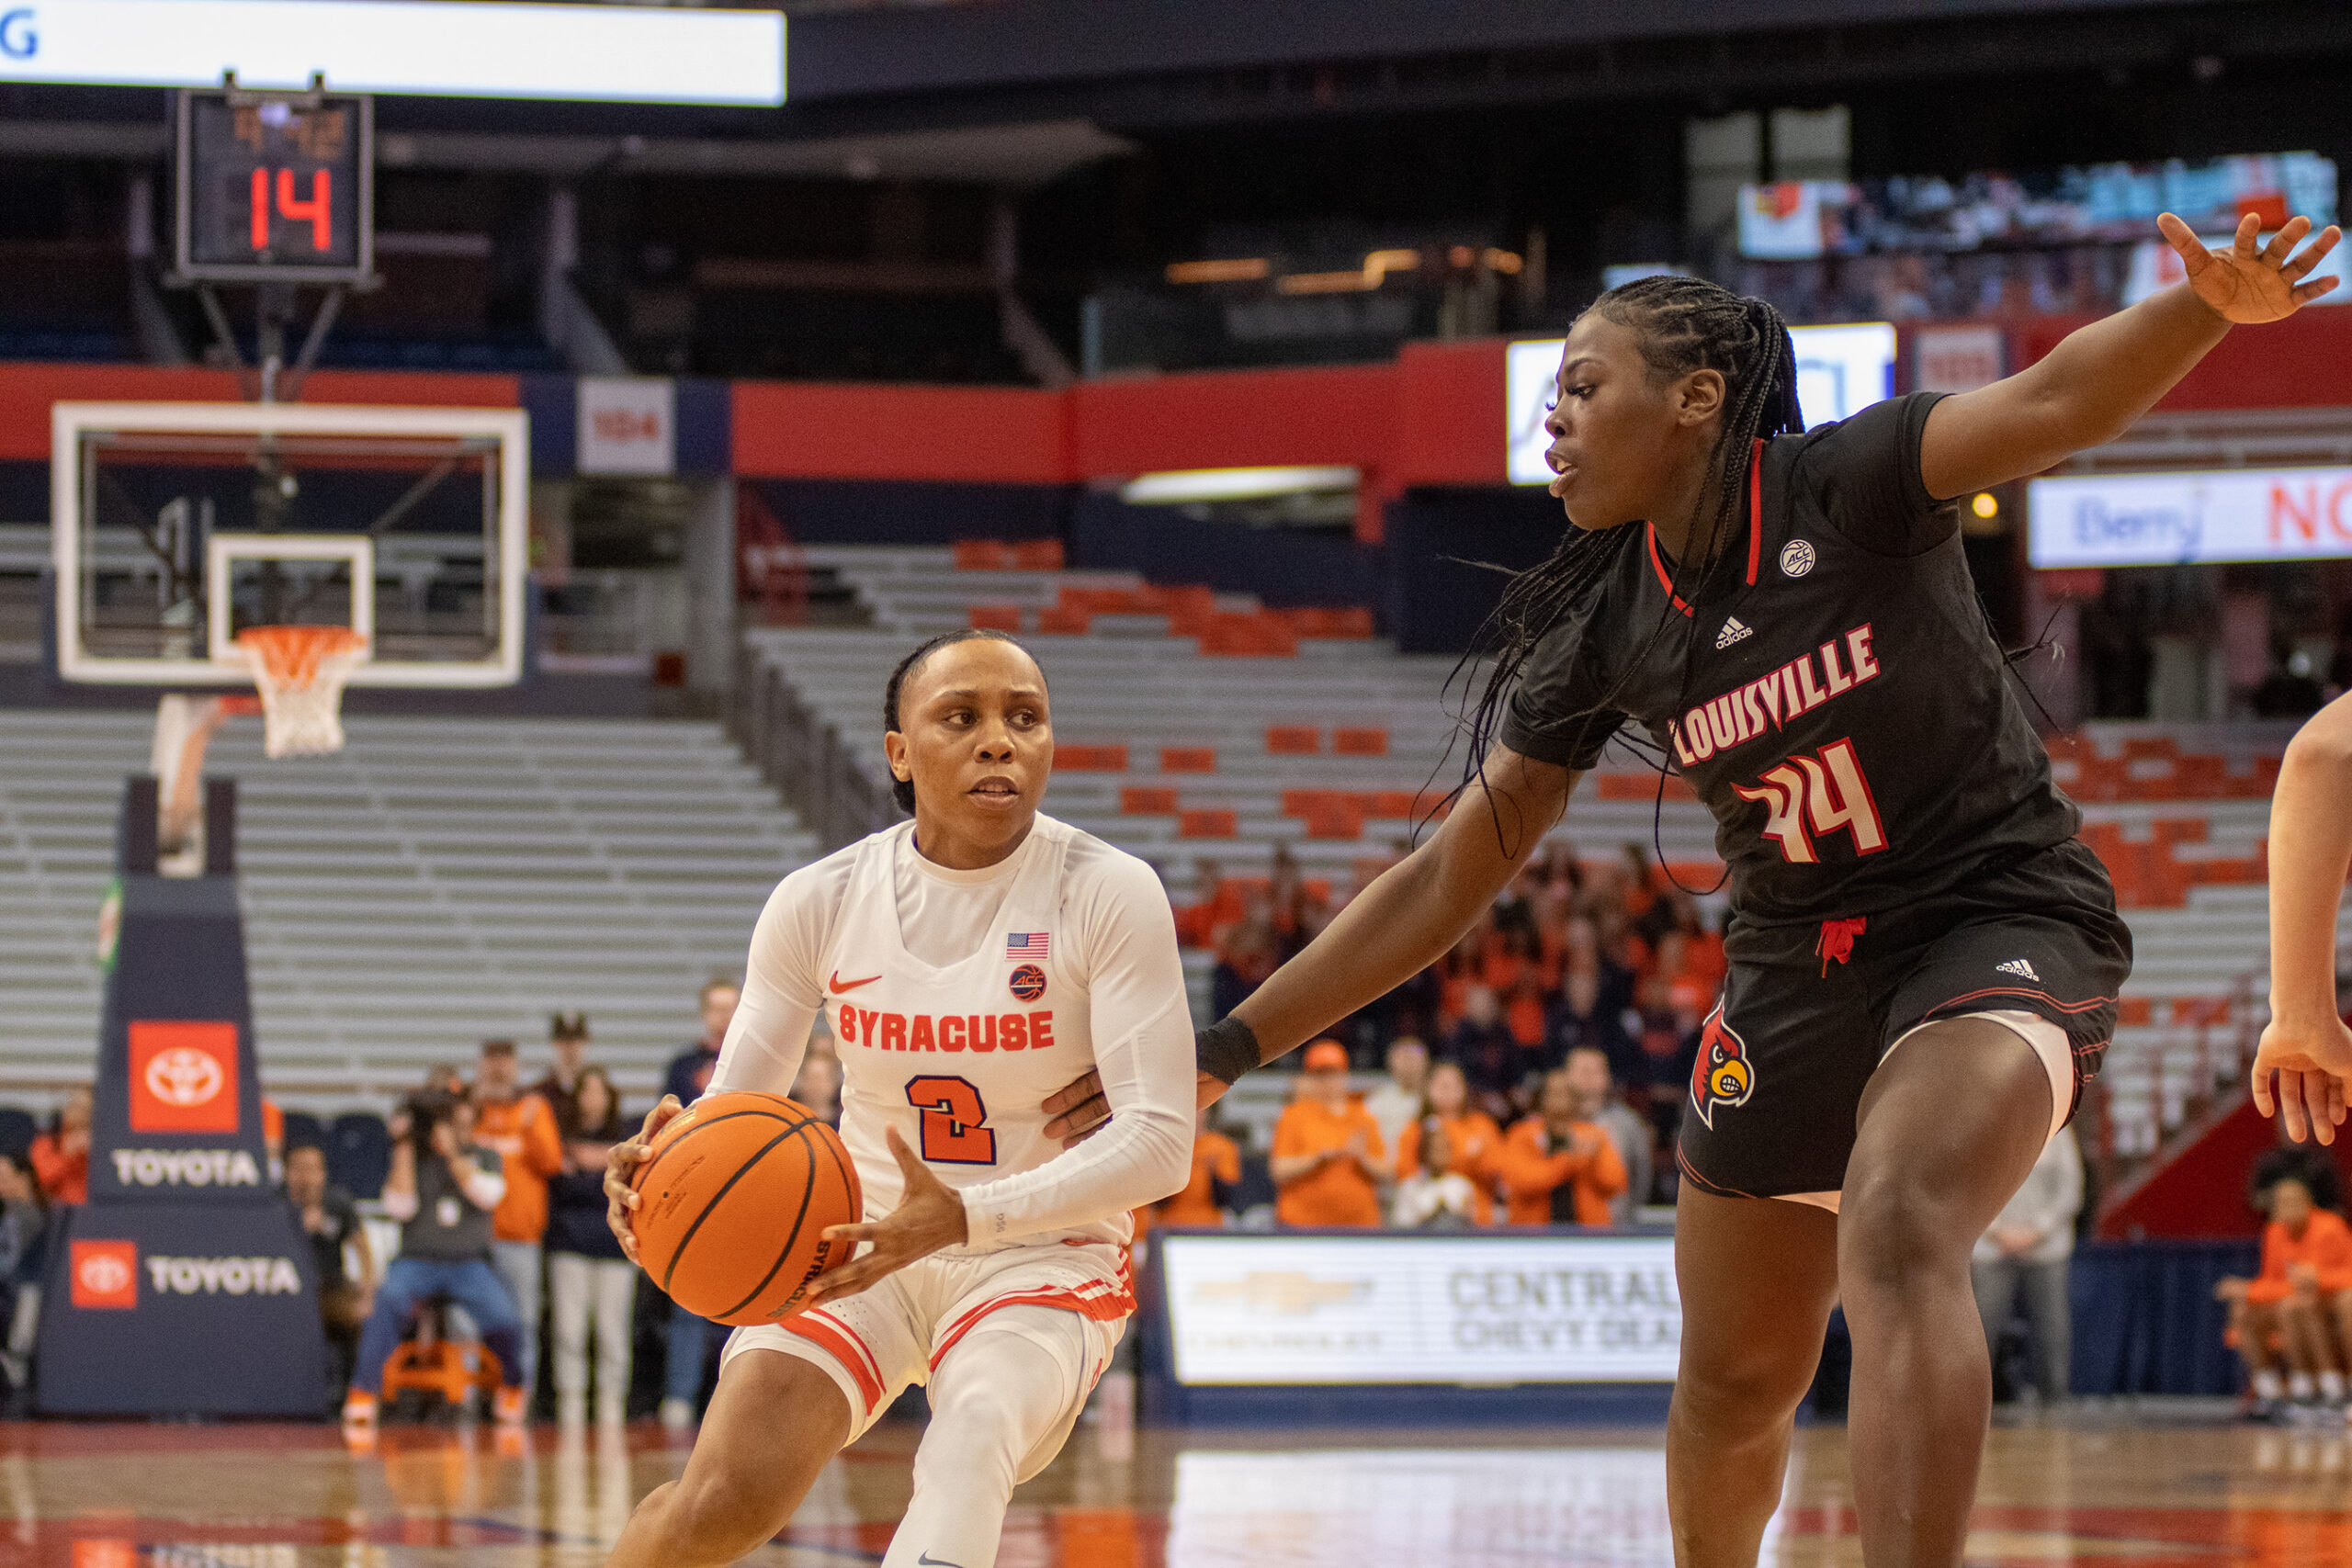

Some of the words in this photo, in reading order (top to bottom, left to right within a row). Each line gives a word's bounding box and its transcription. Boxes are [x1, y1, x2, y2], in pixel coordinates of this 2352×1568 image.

[251, 168, 332, 251] 14
[1786, 546, 1810, 566] ACC
[1716, 627, 1753, 649] adidas
[1668, 622, 1880, 767] LOUISVILLE
[1731, 737, 1889, 863] 44
[1013, 975, 1044, 986] ACC
[1996, 964, 2040, 982] adidas
[840, 1004, 1055, 1053] SYRACUSE
[904, 1075, 997, 1165] 2
[112, 1148, 259, 1187] TOYOTA
[147, 1256, 300, 1296] TOYOTA
[1449, 1264, 1678, 1310] CENTRAL
